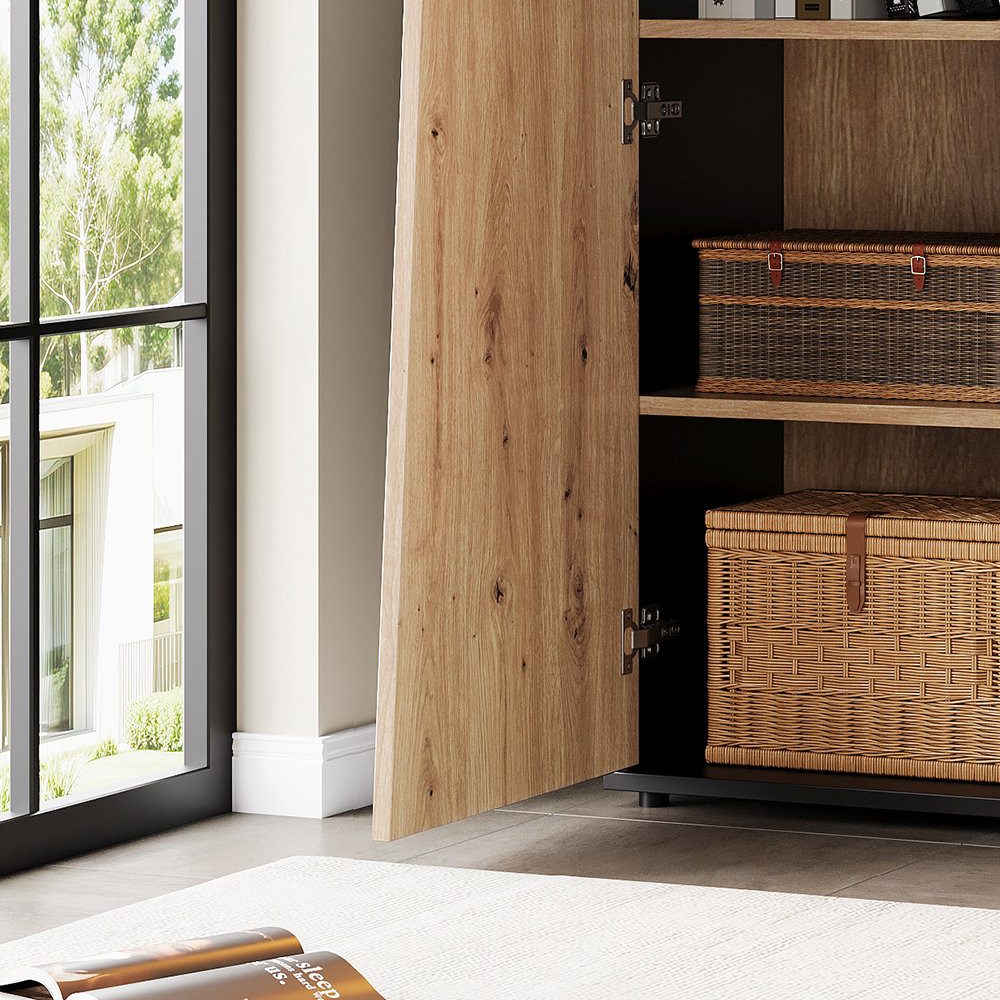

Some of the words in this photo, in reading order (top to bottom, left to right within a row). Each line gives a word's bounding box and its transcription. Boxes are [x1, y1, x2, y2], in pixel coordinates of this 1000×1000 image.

[264, 965, 288, 985] us.
[293, 972, 317, 991] hard
[296, 962, 341, 999] sleep
